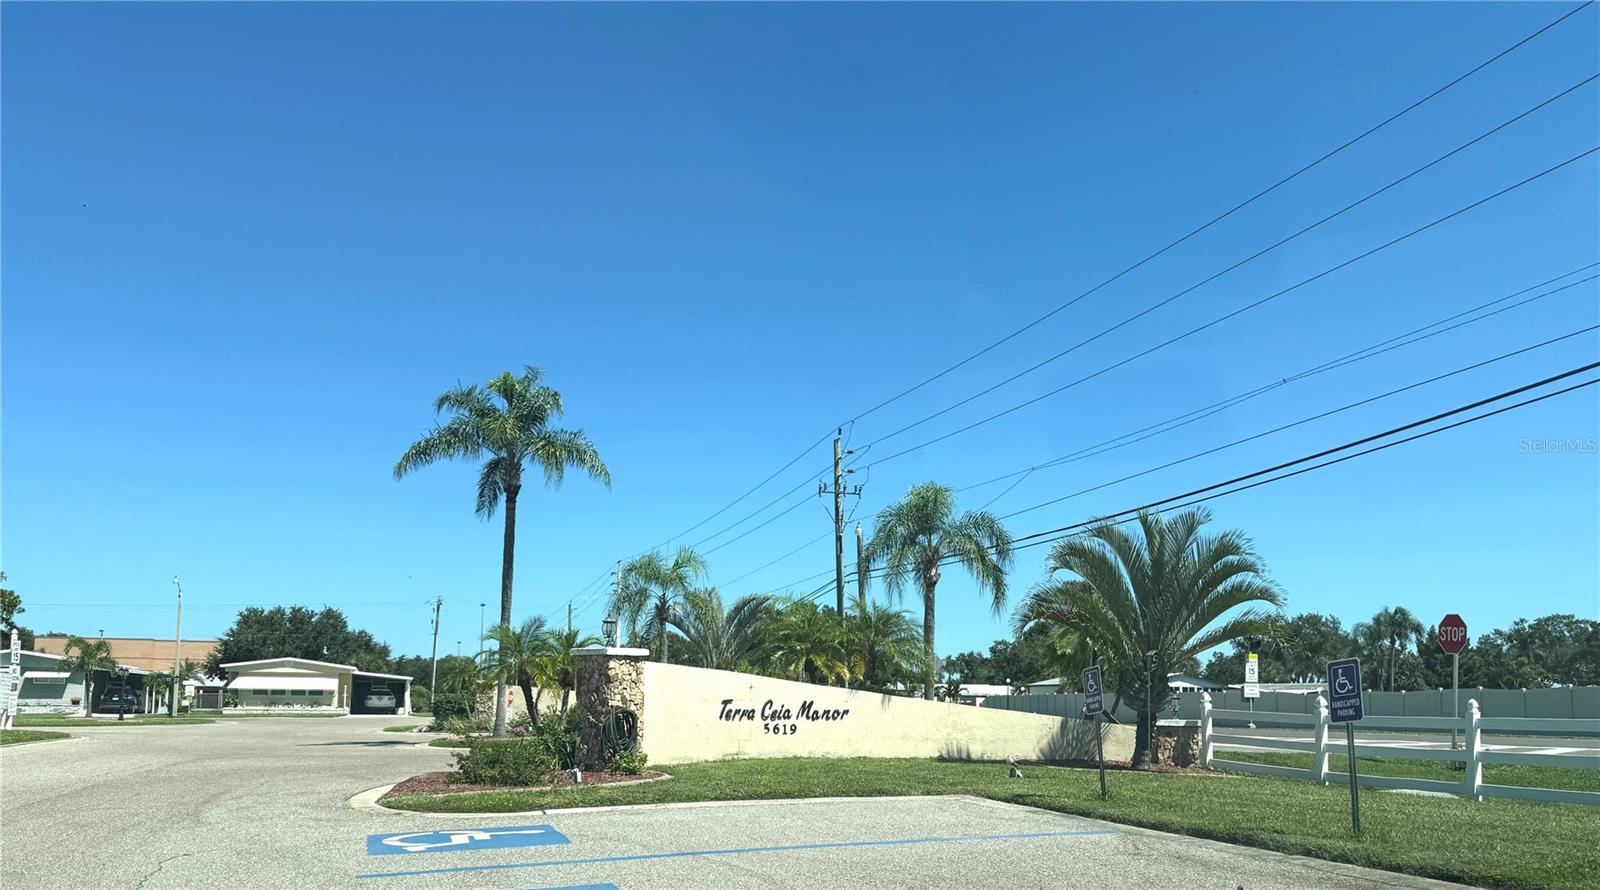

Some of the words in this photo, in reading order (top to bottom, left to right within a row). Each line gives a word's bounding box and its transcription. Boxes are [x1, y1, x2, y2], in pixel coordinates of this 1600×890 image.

[1440, 627, 1465, 642] STOP
[1248, 667, 1256, 675] 15
[1332, 698, 1360, 708] HANDICAPPED
[719, 699, 756, 722] Terra
[760, 699, 792, 722] Ceia
[795, 700, 850, 722] Manor
[1337, 707, 1356, 717] PARKING
[763, 723, 797, 735] 5619
